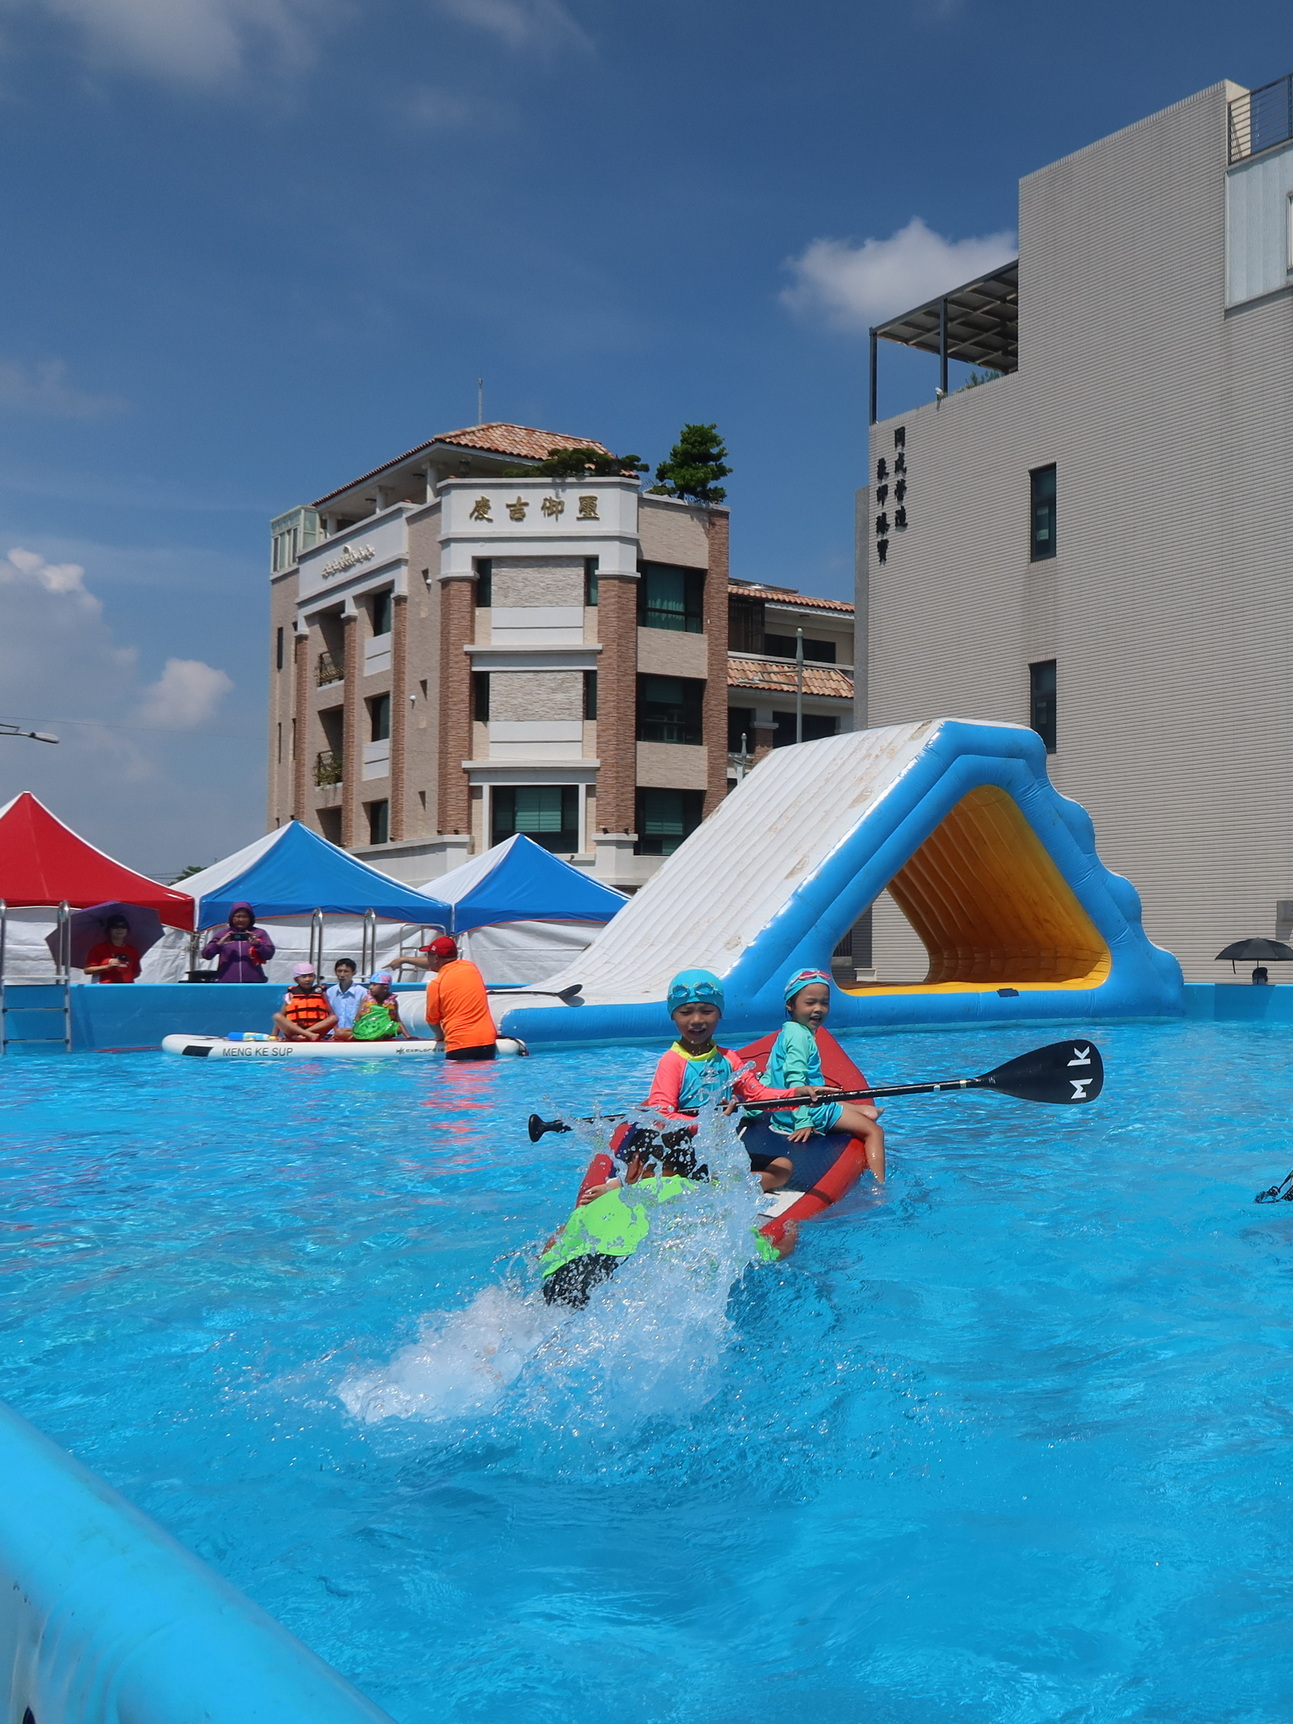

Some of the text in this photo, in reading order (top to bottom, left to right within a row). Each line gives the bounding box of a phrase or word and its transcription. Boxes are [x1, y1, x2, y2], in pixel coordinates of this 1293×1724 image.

[222, 1047, 294, 1057] MENG KE SUP
